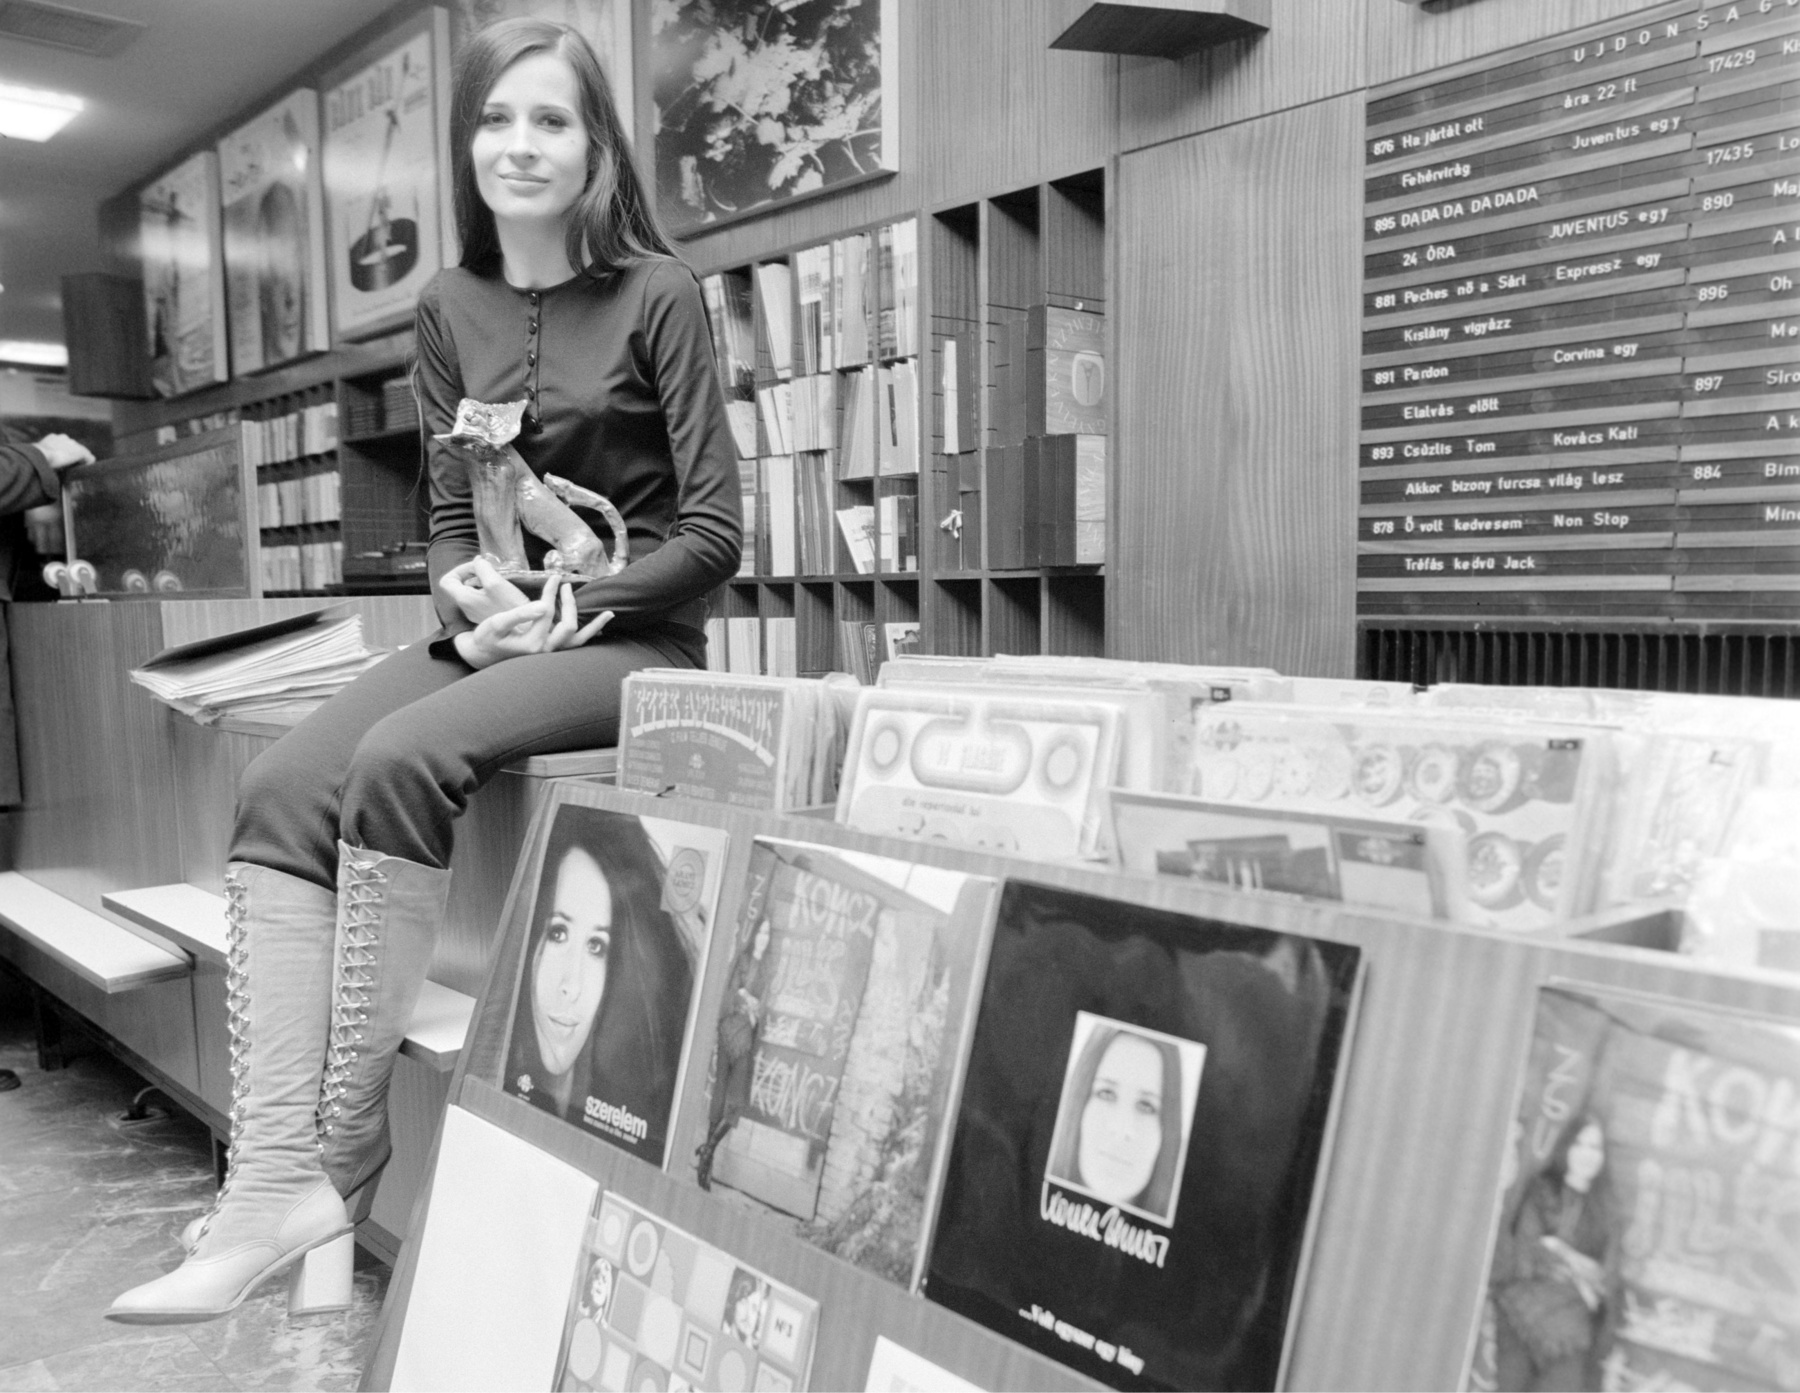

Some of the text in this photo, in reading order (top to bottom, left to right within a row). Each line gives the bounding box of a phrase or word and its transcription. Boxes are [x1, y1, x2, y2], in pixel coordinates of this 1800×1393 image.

[1708, 49, 1756, 73] 17429
[1373, 139, 1395, 156] 876
[1402, 134, 1421, 148] Ha
[1597, 83, 1616, 101] 22
[1624, 78, 1637, 93] ft
[1573, 125, 1640, 149] Juventus
[1649, 116, 1681, 133] egy
[1706, 142, 1754, 165] 17435
[1702, 192, 1734, 211] 890
[1374, 216, 1396, 233] 895
[1403, 252, 1418, 267] 24
[1549, 211, 1629, 239] JUVENTUS
[1638, 207, 1669, 224] egy
[1772, 229, 1786, 244] A
[1375, 294, 1396, 309] 881
[1404, 288, 1449, 304] Peches
[1556, 259, 1622, 282] Expressz
[1636, 253, 1661, 268] egy
[1698, 284, 1728, 302] 896
[1374, 343, 1639, 385] 891 Pardon Corvina egy
[1694, 375, 1723, 392] 897
[1766, 415, 1780, 430] A
[1372, 446, 1394, 460] 893
[1466, 439, 1496, 453] Tom
[1608, 426, 1638, 440] Kati
[1405, 481, 1443, 495] Akkor
[1451, 480, 1492, 494] bizony
[1498, 477, 1541, 490] furcsa
[1592, 471, 1624, 485] lesz
[1693, 465, 1721, 480] 884
[1372, 521, 1394, 534] 878
[1419, 519, 1443, 533] volt
[1454, 518, 1523, 531] kedvesem
[1553, 514, 1583, 527] Non
[1593, 512, 1629, 529] Stop
[1503, 556, 1536, 570] Jack
[585, 1095, 648, 1140] szerelem
